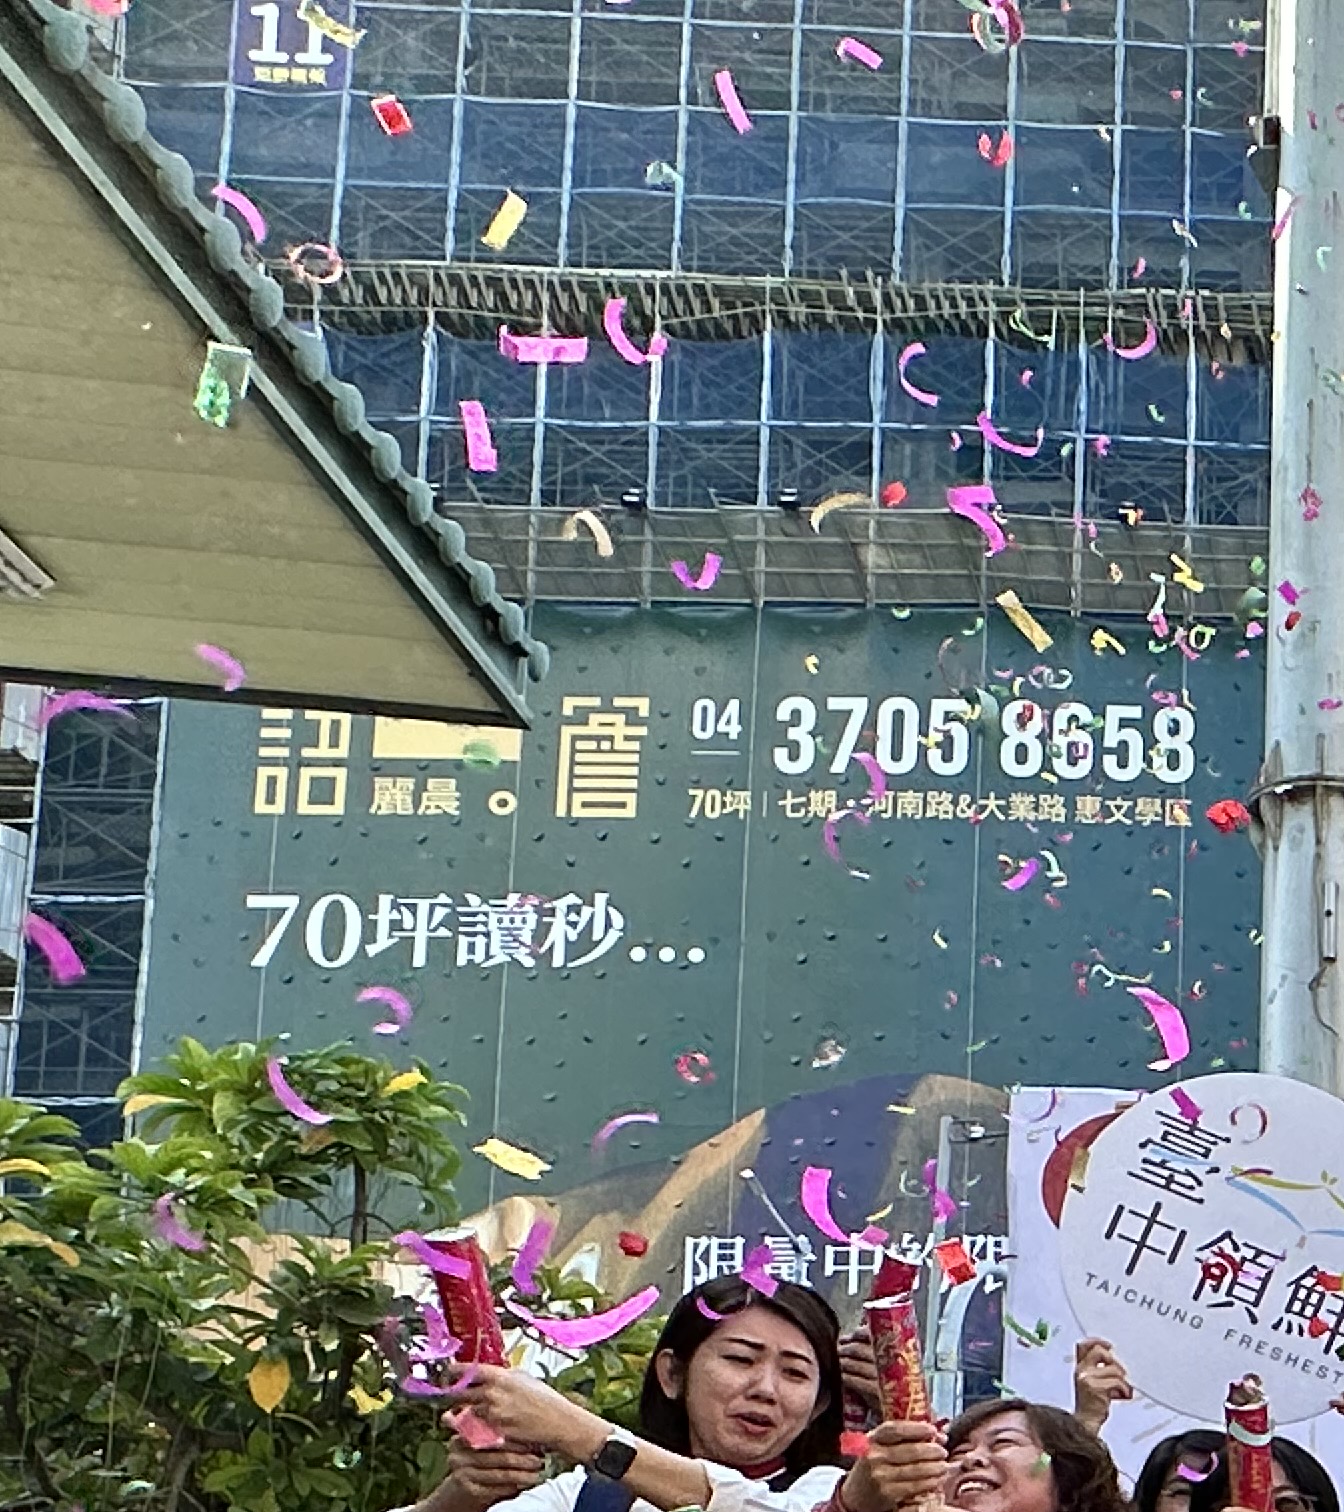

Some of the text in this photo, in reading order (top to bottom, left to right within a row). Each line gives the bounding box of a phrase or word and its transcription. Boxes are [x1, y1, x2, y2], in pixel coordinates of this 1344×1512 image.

[248, 2, 335, 65] 11
[691, 695, 1196, 784] 04 3705 8658
[368, 776, 461, 817] 麗晨
[688, 788, 752, 821] 70坪
[1085, 1272, 1205, 1330] TAICHUNG
